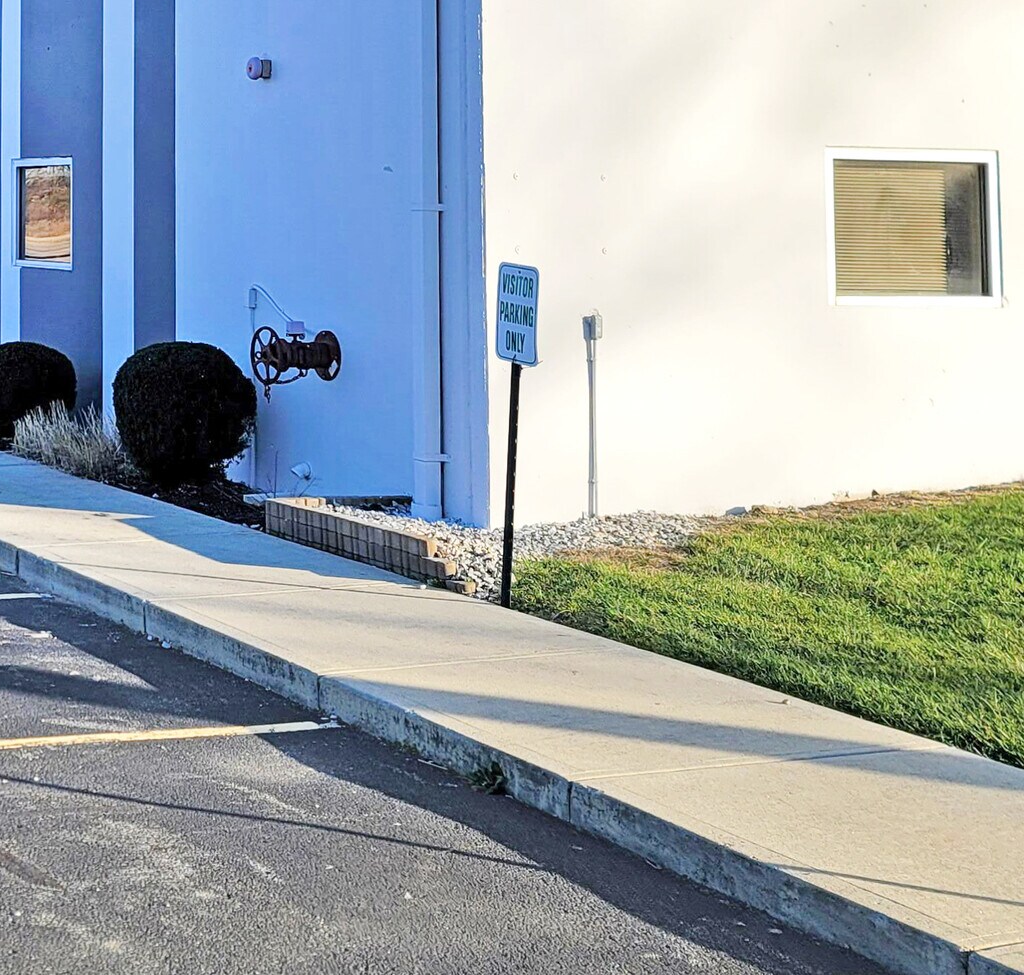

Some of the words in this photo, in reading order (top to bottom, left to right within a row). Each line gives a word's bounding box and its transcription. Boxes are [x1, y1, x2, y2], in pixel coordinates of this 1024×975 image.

[502, 273, 534, 299] VISITOR
[499, 301, 534, 328] PARKING
[505, 330, 526, 354] ONLY
